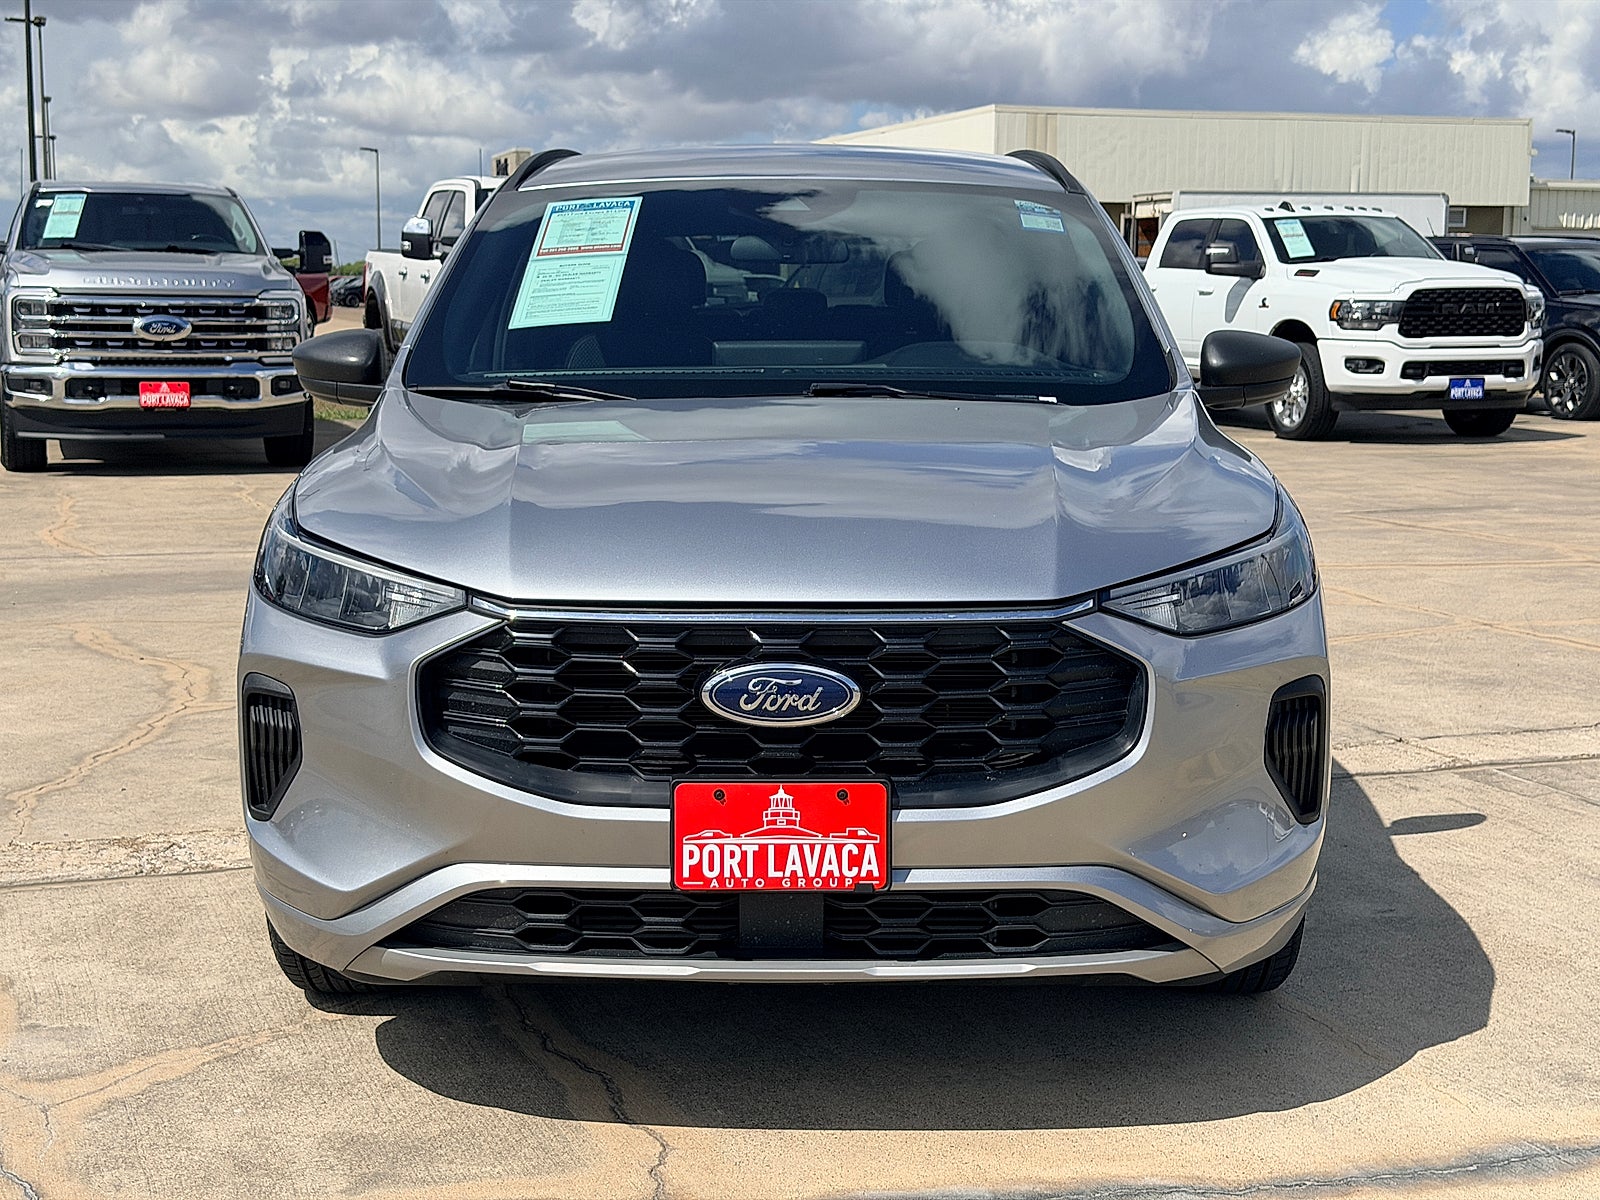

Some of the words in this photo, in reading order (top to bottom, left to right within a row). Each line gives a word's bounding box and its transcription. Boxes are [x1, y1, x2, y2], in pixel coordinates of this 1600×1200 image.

[142, 394, 160, 404] PORT
[161, 394, 189, 404] LAVACA
[739, 677, 824, 711] Ford
[682, 844, 759, 878] PORT
[767, 844, 880, 878] LAVACA
[709, 878, 765, 888] AUTO
[782, 878, 853, 888] GROUP
